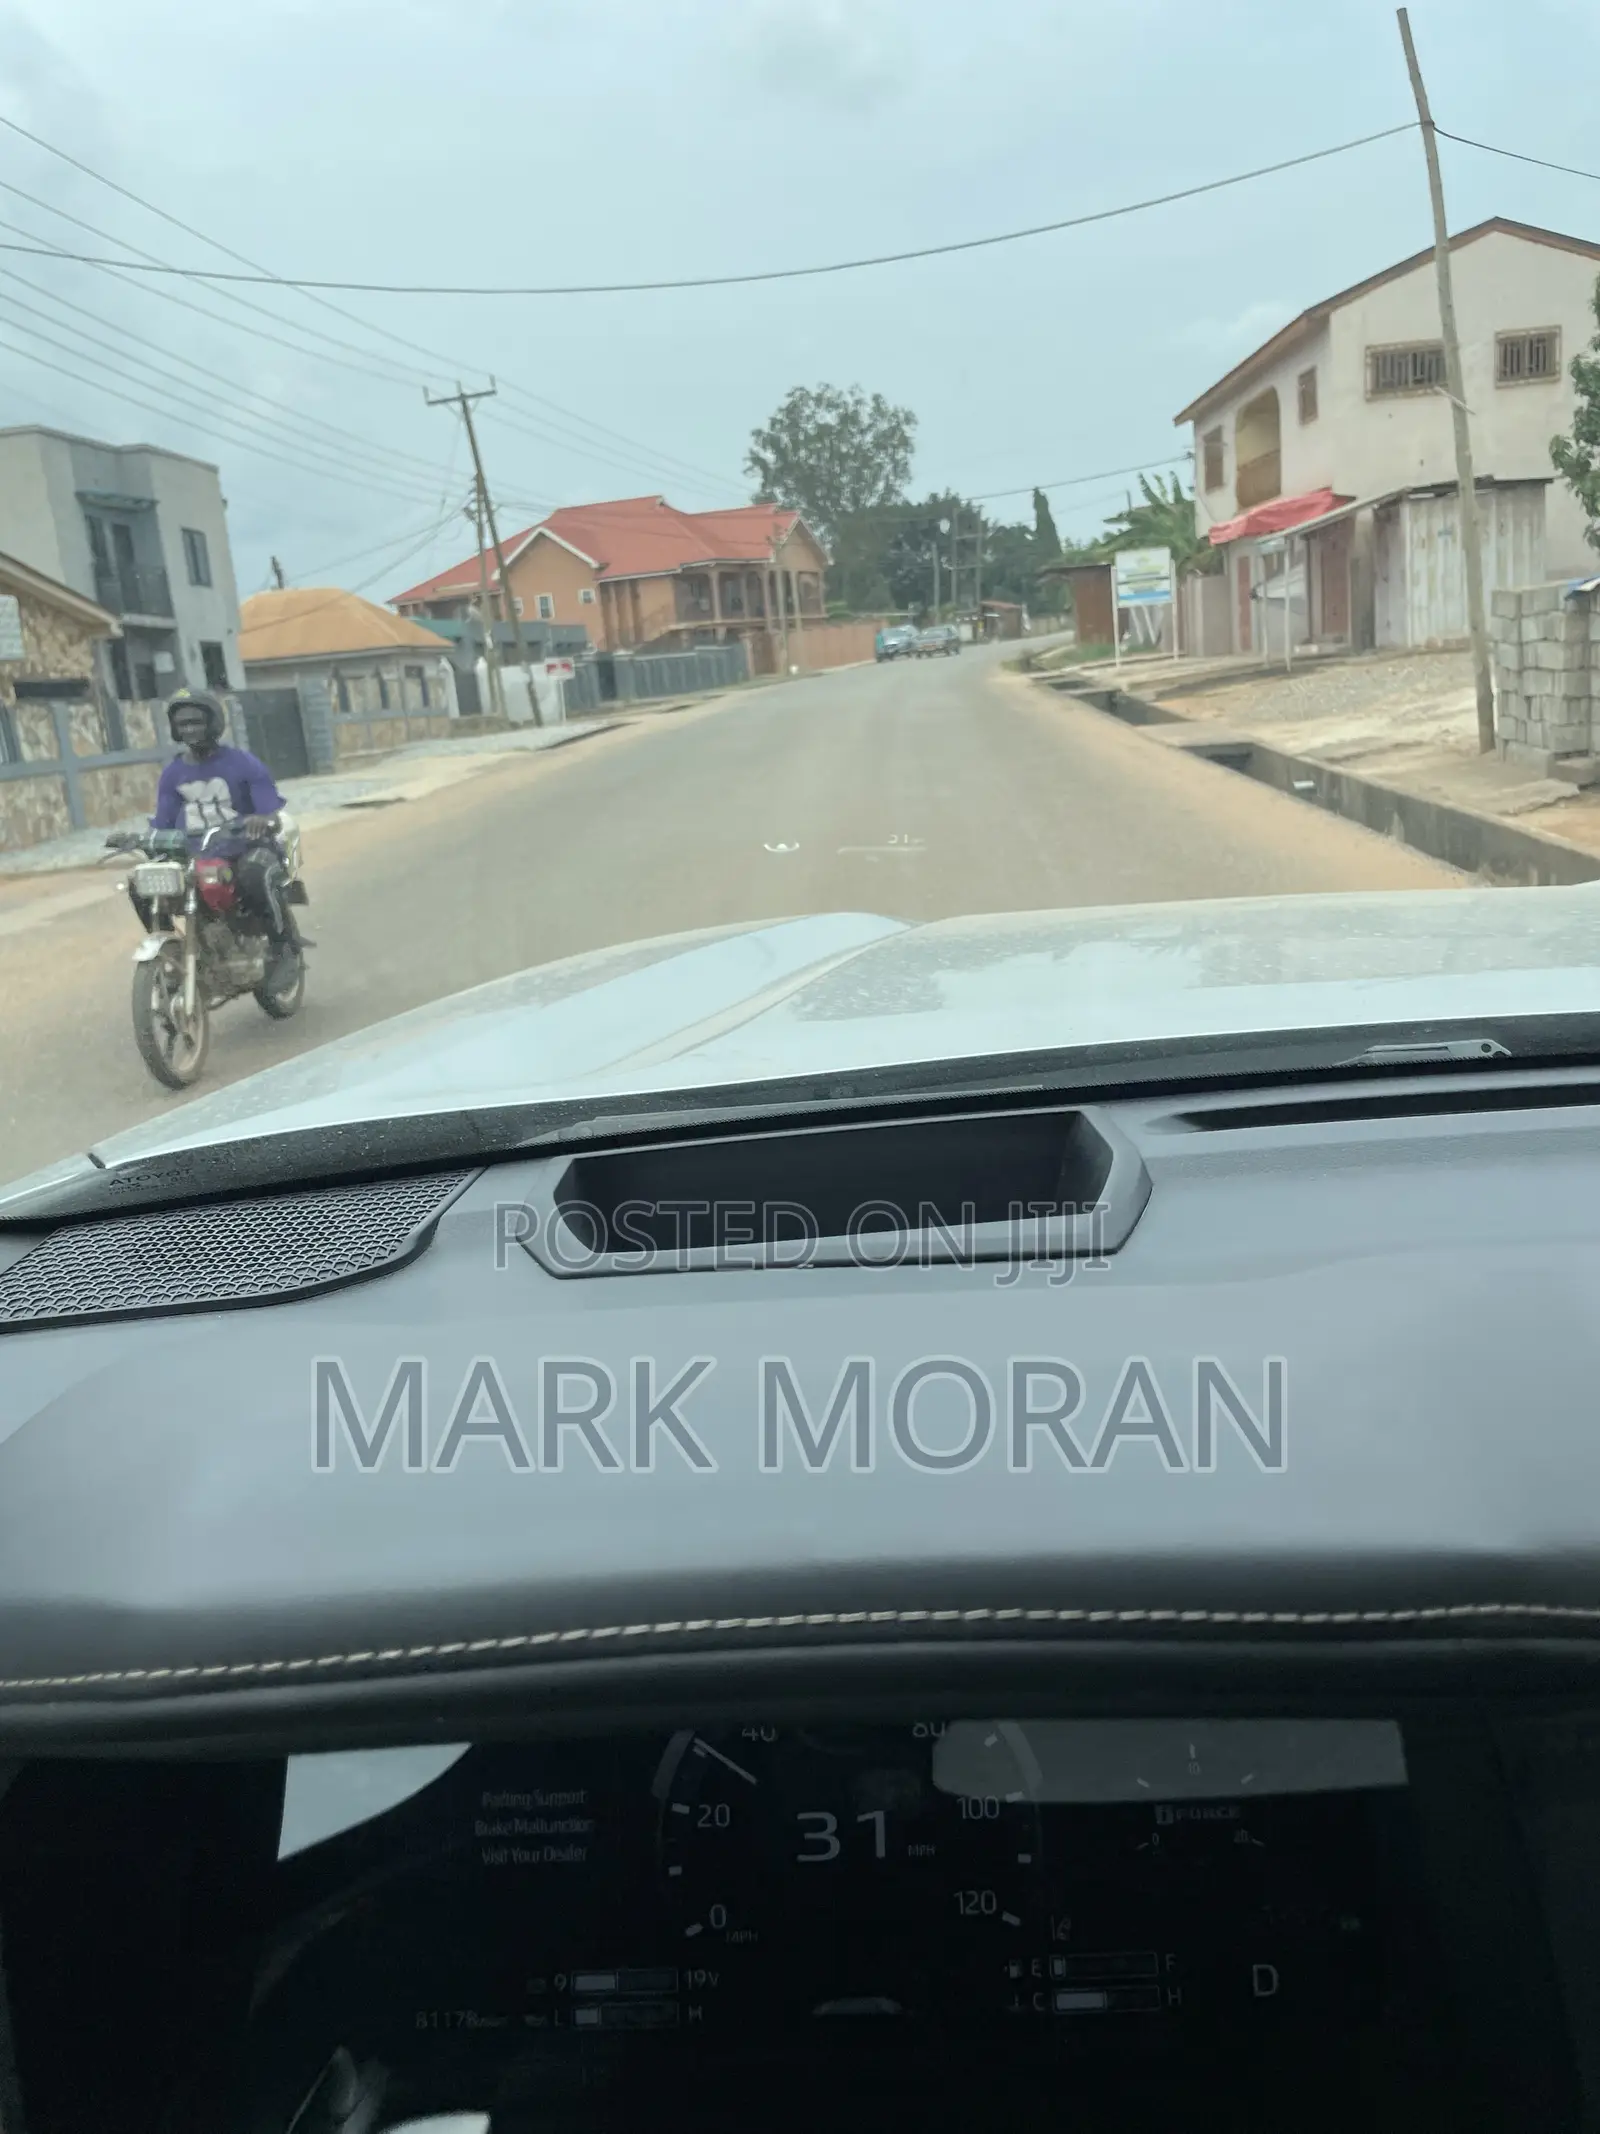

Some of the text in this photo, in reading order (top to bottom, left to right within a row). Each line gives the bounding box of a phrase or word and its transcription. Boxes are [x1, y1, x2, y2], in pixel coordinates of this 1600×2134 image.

[697, 1803, 731, 1828] 20
[957, 1795, 1000, 1820] 100
[796, 1810, 887, 1863] 31
[953, 1889, 997, 1915] 120
[708, 1903, 728, 1930] 0
[1252, 1964, 1279, 1997] D
